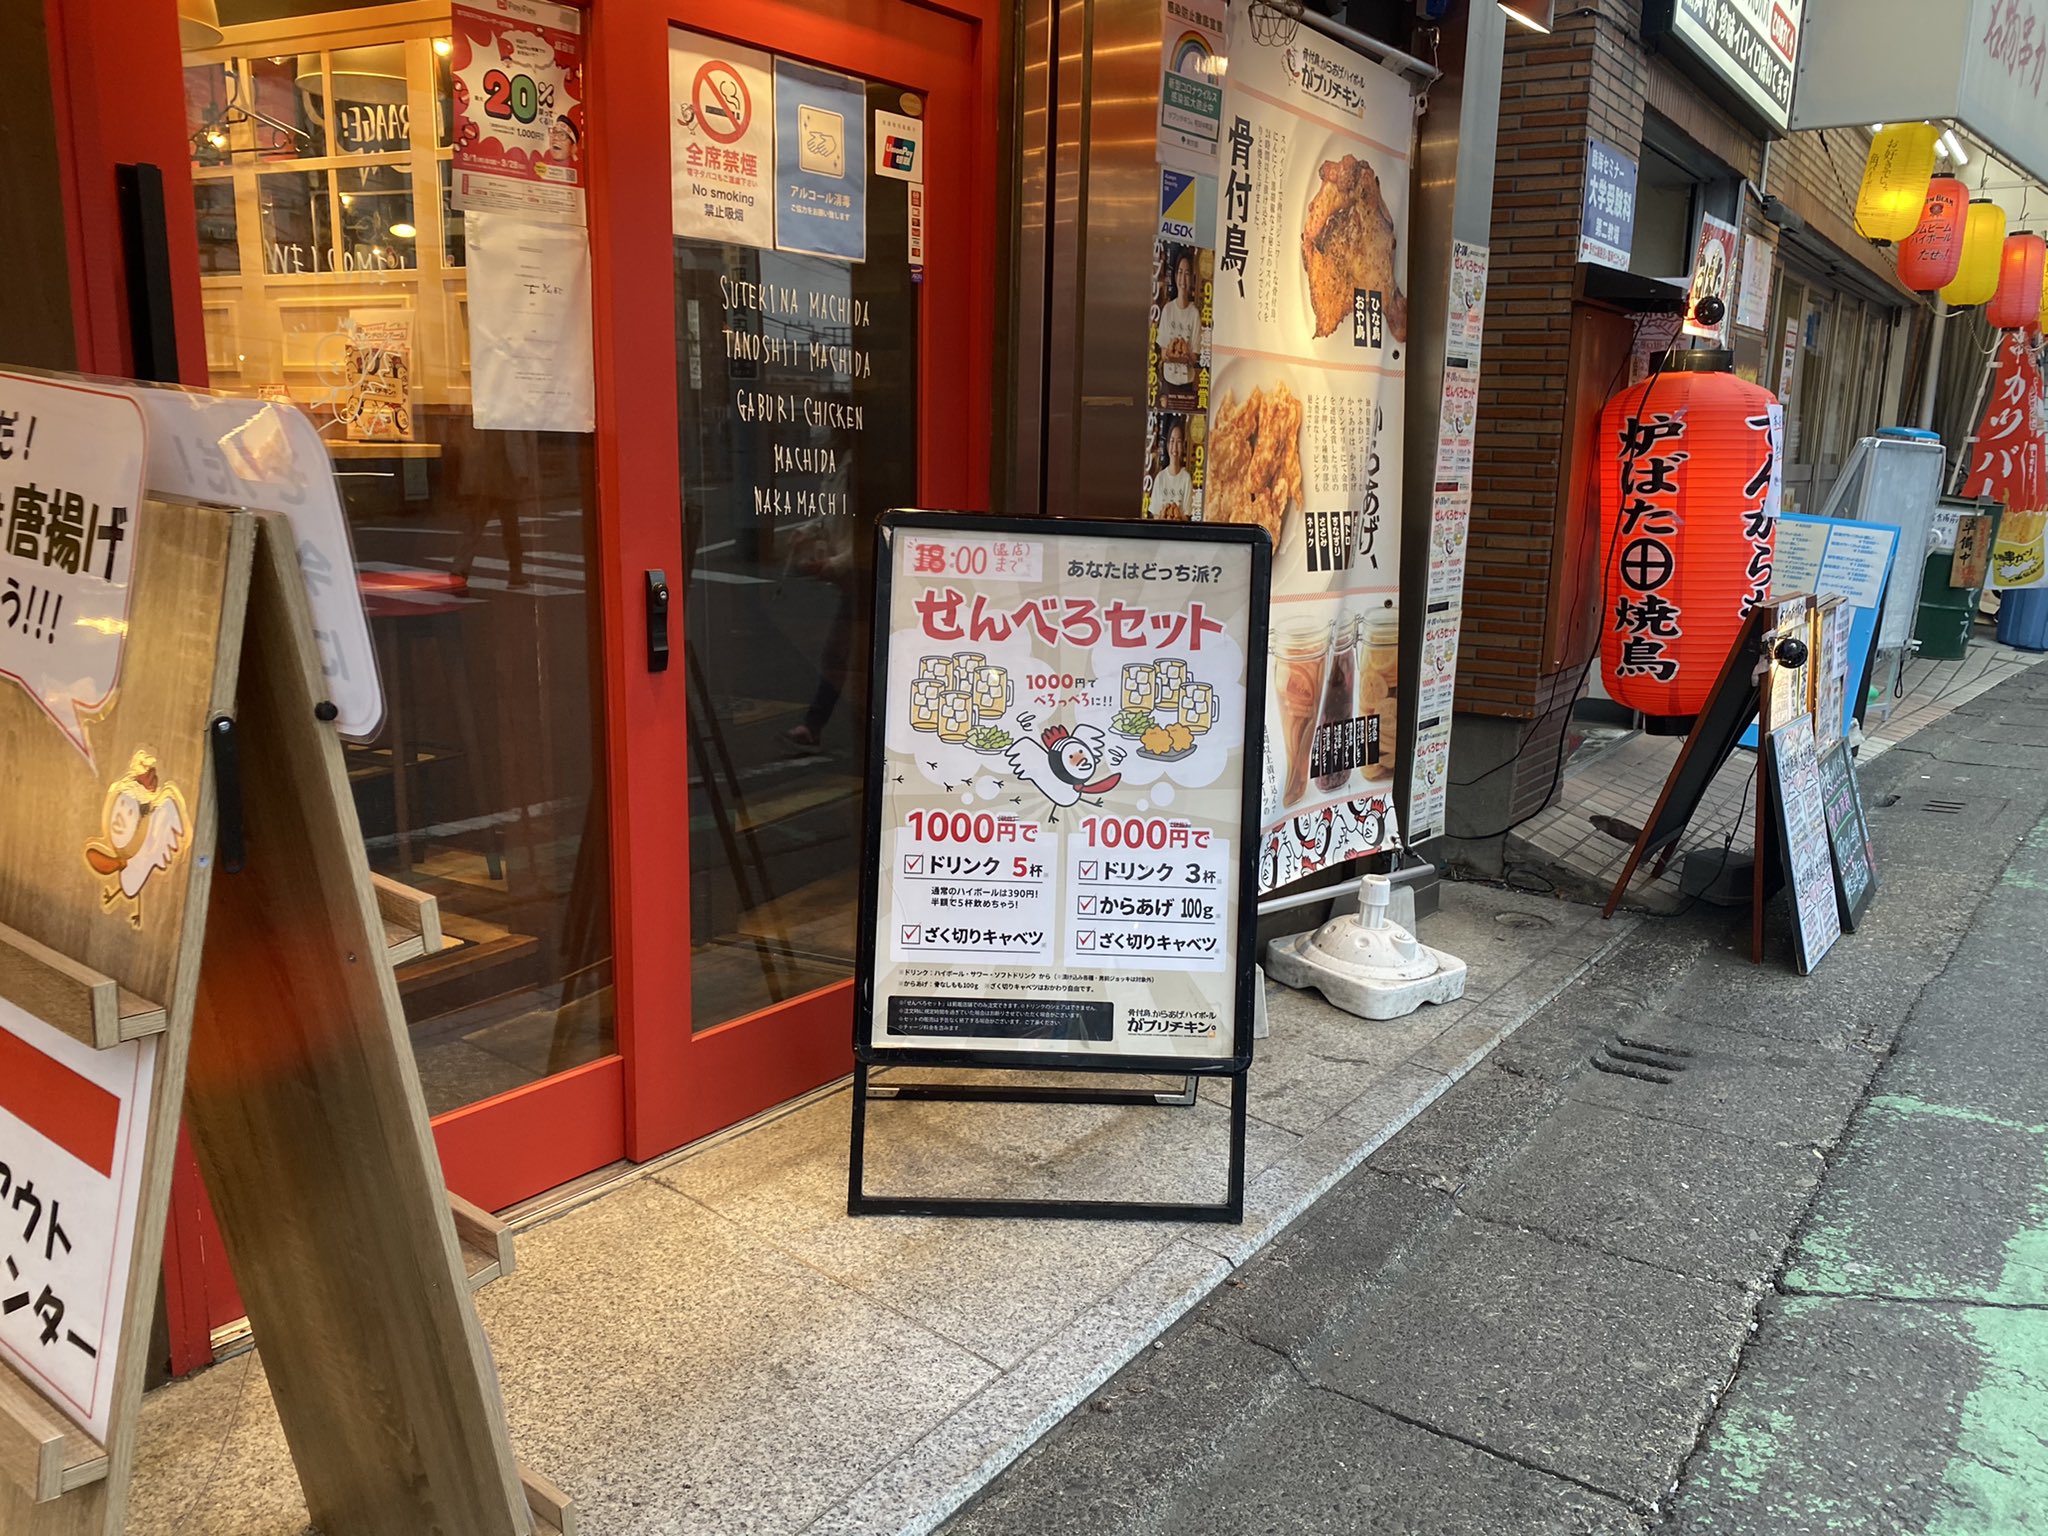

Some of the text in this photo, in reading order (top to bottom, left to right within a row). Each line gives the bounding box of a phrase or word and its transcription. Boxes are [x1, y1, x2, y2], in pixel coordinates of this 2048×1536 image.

[686, 142, 758, 178] 全席禁煙
[692, 183, 755, 207] No smoking
[790, 185, 851, 208] アルコール消毒
[1161, 221, 1193, 239] ALSOK
[720, 275, 870, 327] SUTEKINA MACHIDA
[809, 341, 871, 379] MACHIDA
[736, 388, 863, 431] GABURI CHICKEN
[774, 443, 836, 474] MACHIDA
[1306, 516, 1314, 547] ネック
[1319, 516, 1328, 547] ささみ
[1959, 518, 1977, 566] 準備中
[1614, 414, 1689, 683] 炉ばた 焼鳥
[1067, 559, 1223, 584] あなたはどっち派?
[1025, 674, 1098, 690] 1000円で
[908, 811, 1038, 844] 1000円で
[1082, 817, 1210, 850] 1000円で
[930, 855, 1043, 878] ドリンク 5杯
[1105, 861, 1216, 884] ドリンク 3杯
[931, 886, 1038, 899] 通常のハイボールは390円!
[931, 898, 1019, 909] 半額で5杯飲めちゃう!
[1100, 896, 1214, 919] からあげ 100g
[924, 926, 1044, 946] ざく切りキャベツ
[1100, 932, 1217, 952] ざく切りキャベツ
